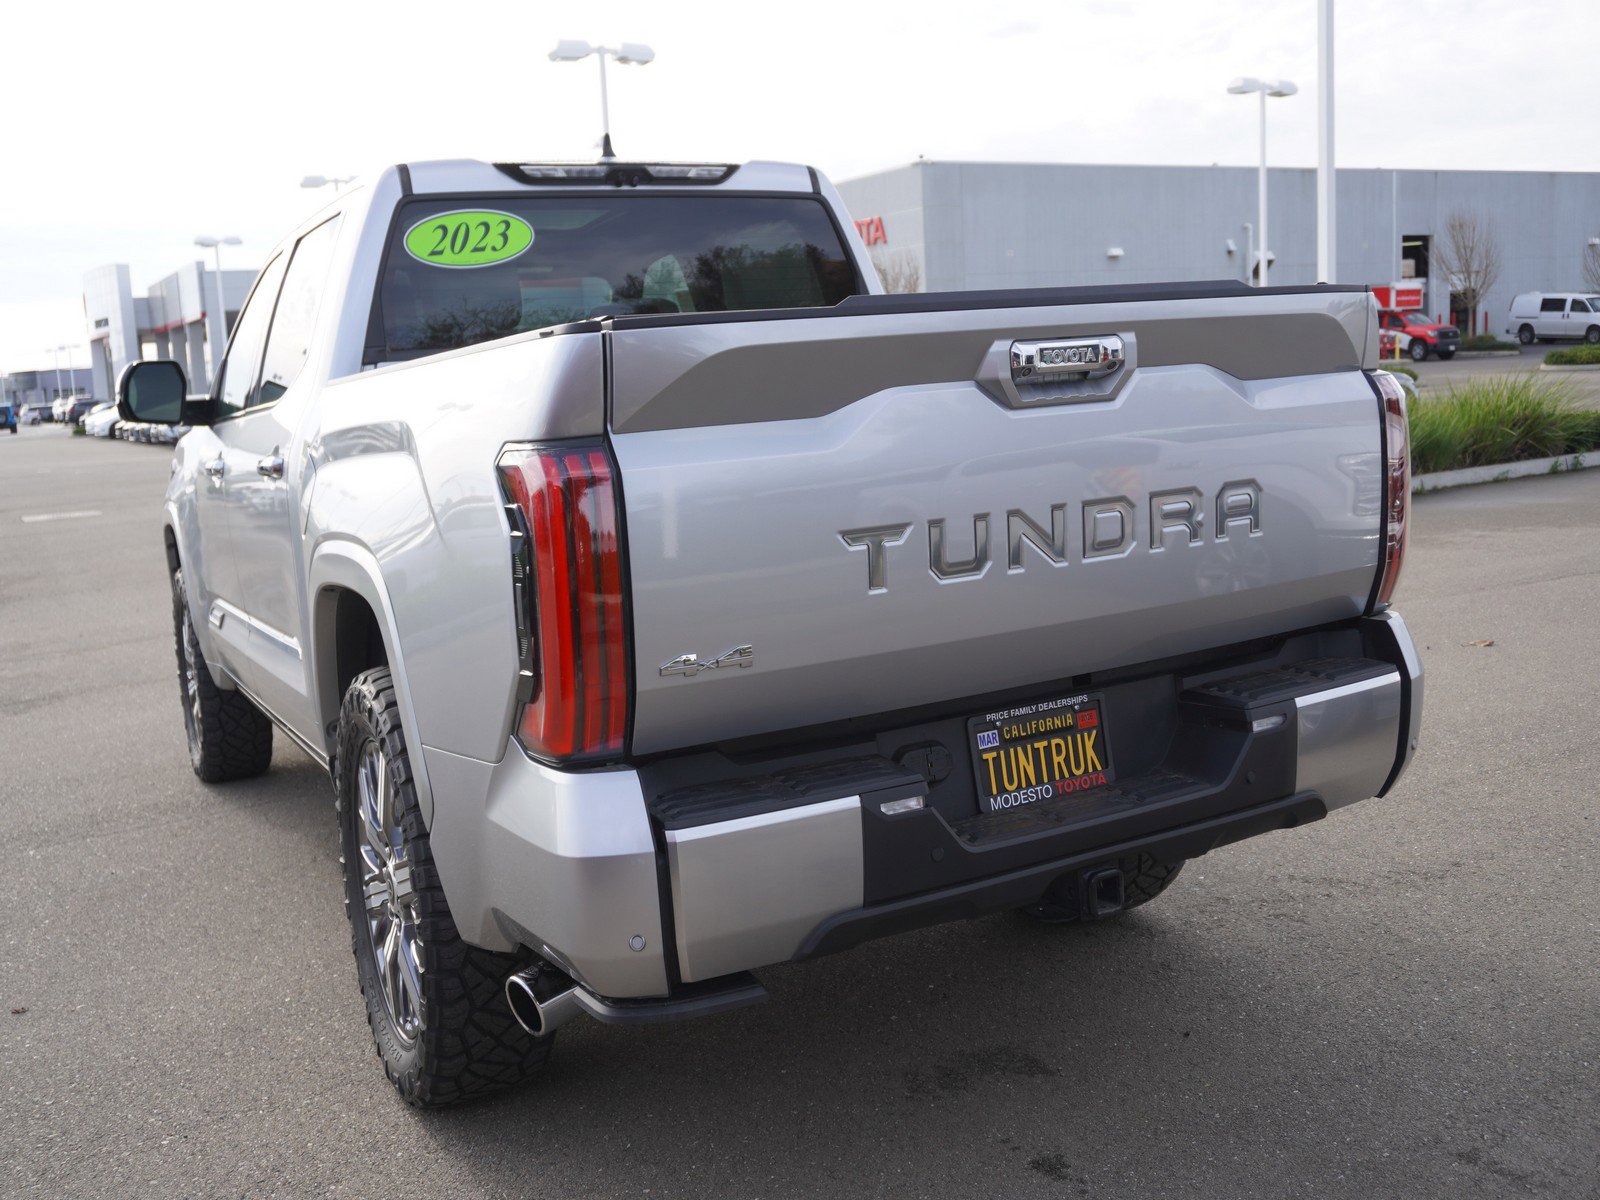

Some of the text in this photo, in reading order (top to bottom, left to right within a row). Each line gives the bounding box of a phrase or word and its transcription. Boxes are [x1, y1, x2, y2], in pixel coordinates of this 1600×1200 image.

[427, 219, 511, 257] 2023
[1043, 347, 1097, 365] TOYOTA
[837, 477, 1264, 596] TUNDRA
[986, 694, 1088, 722] PRICE FAMILY DEALERSHIPS
[978, 731, 998, 748] MAR
[1003, 713, 1074, 739] CALIFORNIA
[982, 729, 1102, 796] TUNTRUK
[990, 772, 1107, 811] MODESTO TOYOTA
